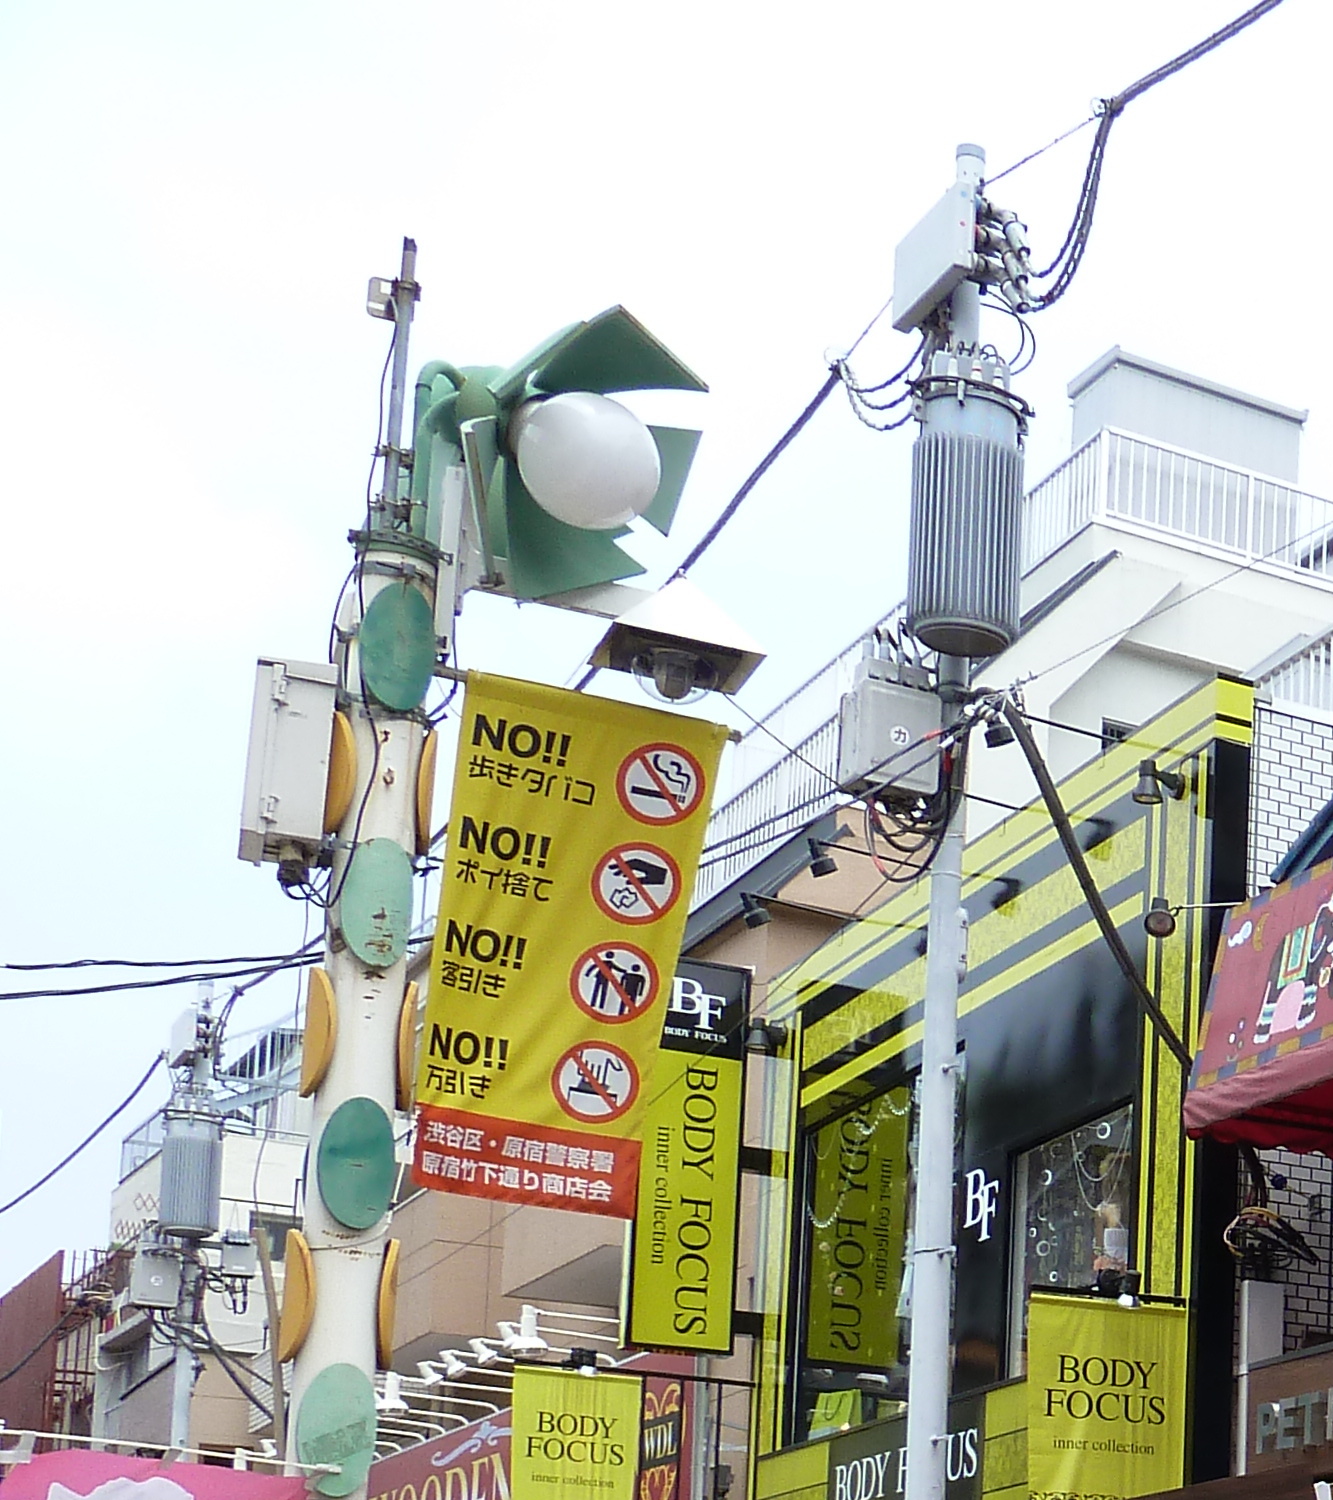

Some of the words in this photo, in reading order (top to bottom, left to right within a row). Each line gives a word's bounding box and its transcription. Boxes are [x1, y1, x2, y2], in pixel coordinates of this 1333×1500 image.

[471, 714, 571, 767] NO!!
[468, 755, 596, 806] 歩きタバコ
[459, 816, 552, 869] NO!!
[456, 860, 553, 902] ポイ捨て
[445, 919, 527, 970] NO!!
[441, 961, 506, 1000] 客引き
[668, 976, 727, 1029] BF
[428, 1023, 508, 1070] NO!!
[664, 1026, 691, 1038] BODY
[694, 1031, 727, 1043] FOCUS
[425, 1064, 492, 1099] 万引き
[681, 1063, 718, 1181] BODY
[423, 1120, 614, 1174] 渋谷区・原宿警察署
[655, 1125, 675, 1173] inner
[421, 1150, 613, 1203] 原宿竹下通り商店会
[651, 1176, 673, 1265] collection
[963, 1168, 999, 1243] BF
[673, 1196, 713, 1336] FOCUS
[1058, 1355, 1157, 1389] BODY
[536, 1411, 617, 1439] BODY
[1045, 1388, 1166, 1425] FOCUS
[1256, 1394, 1319, 1454] PET
[525, 1436, 624, 1466] FOCUS
[644, 1426, 677, 1458] WDL
[896, 1428, 977, 1493] FUS
[1053, 1437, 1083, 1450] inner
[1086, 1438, 1155, 1456] collection
[531, 1473, 558, 1484] inner
[562, 1474, 615, 1489] collection
